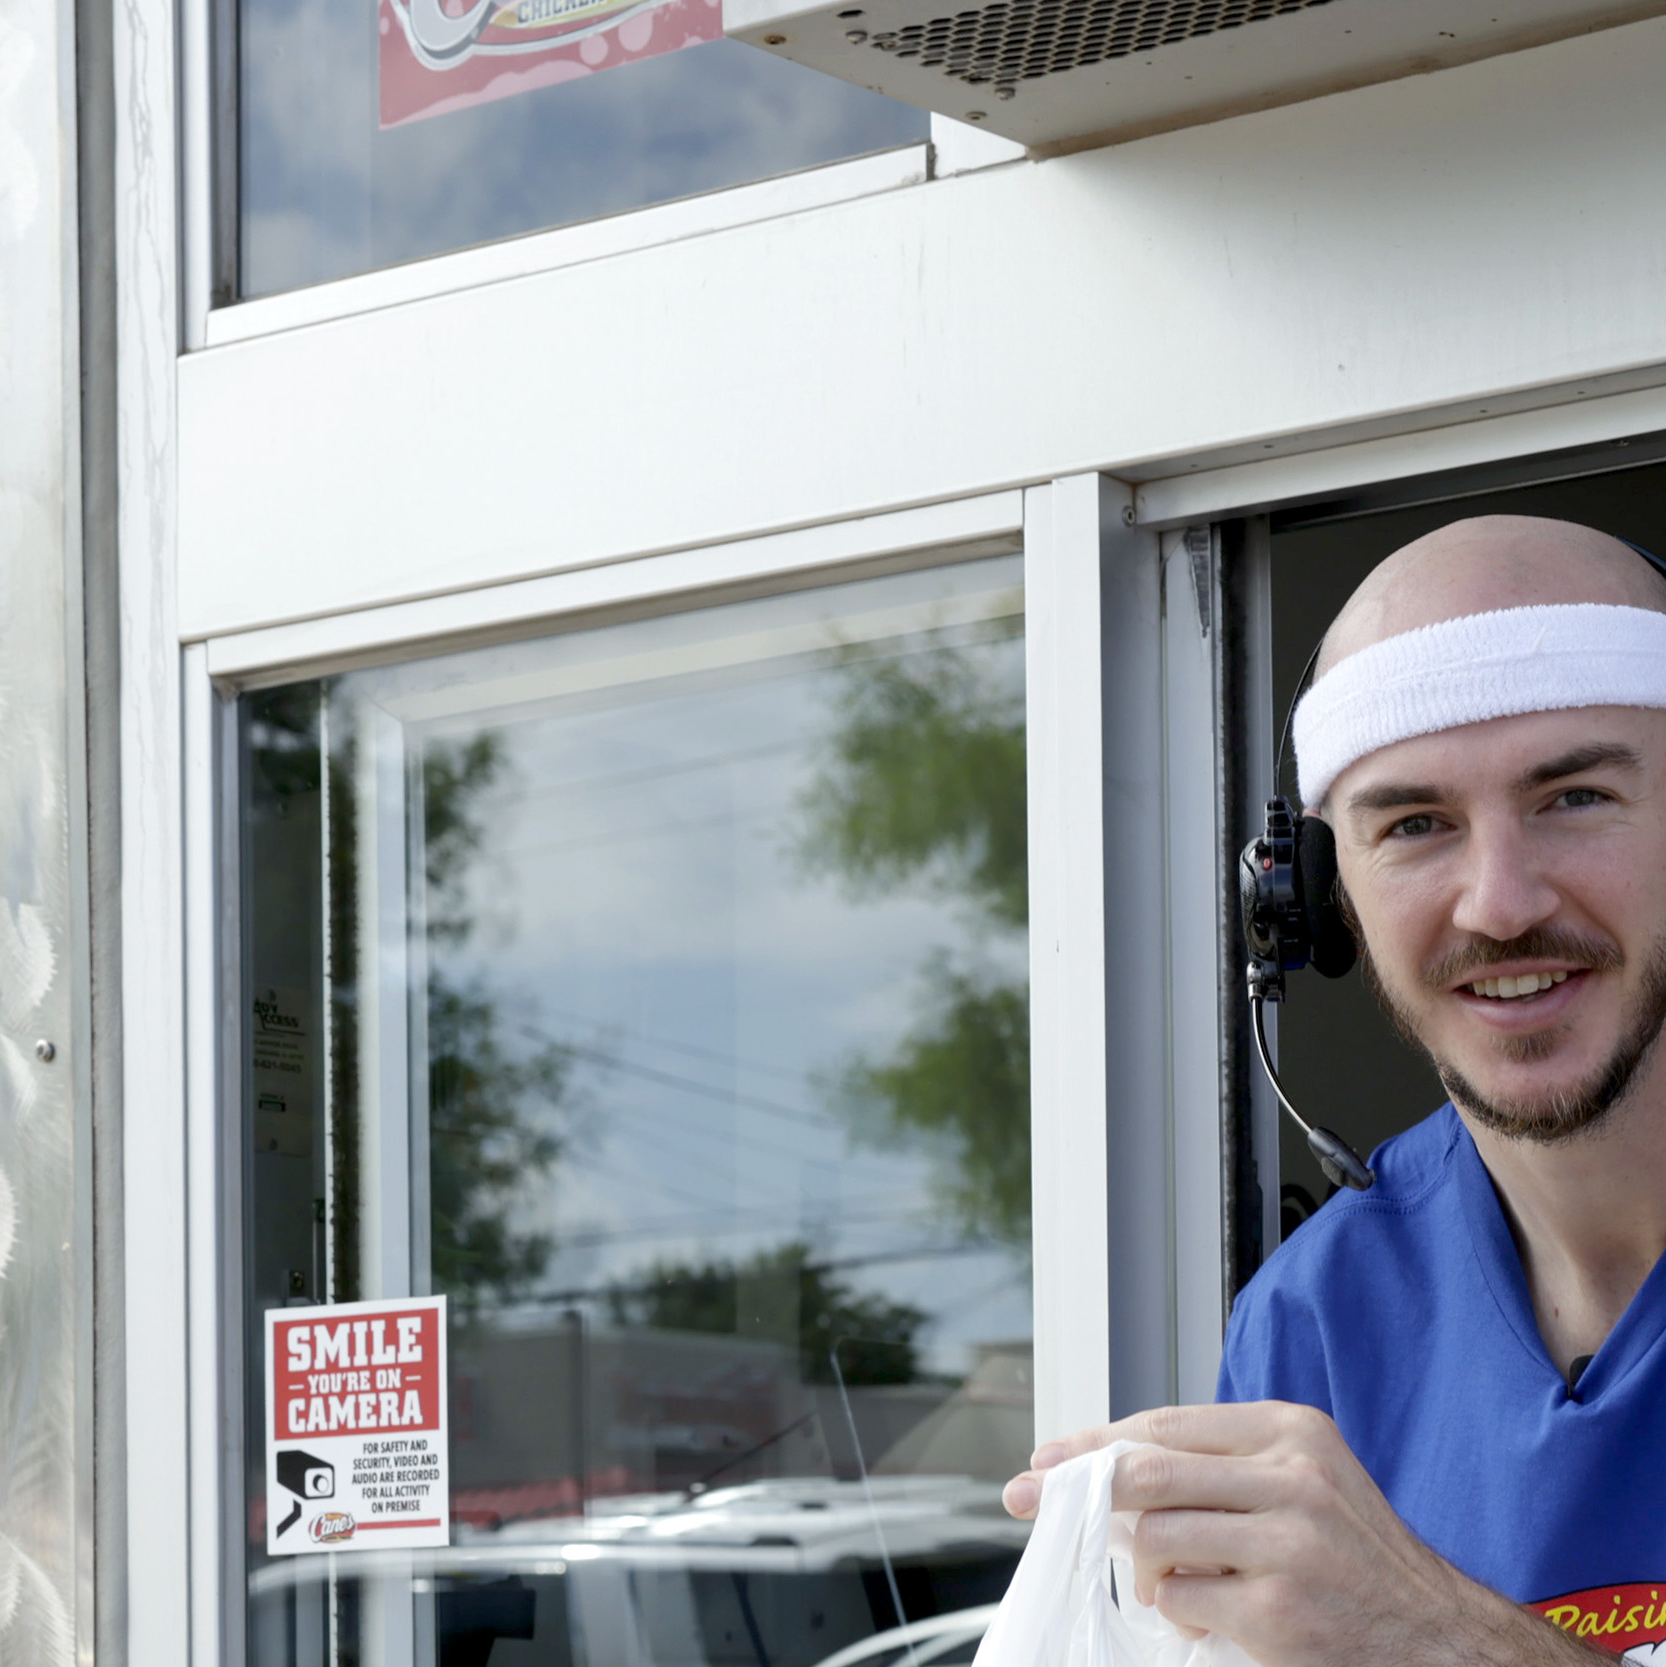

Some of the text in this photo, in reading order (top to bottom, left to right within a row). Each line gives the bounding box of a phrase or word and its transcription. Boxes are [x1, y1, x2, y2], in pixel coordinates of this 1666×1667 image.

[287, 1316, 422, 1372] SMILE
[307, 1368, 401, 1394] YOU'RE ON
[288, 1389, 423, 1433] CAMERA
[363, 1439, 428, 1454] FOR SAFETY AND
[353, 1454, 438, 1470] SECURITY, VIDEO AND
[352, 1469, 440, 1485] AUDIO ARE RECORDED
[362, 1484, 430, 1499] FOR ALL ACTIVITY
[371, 1500, 421, 1513] ON PREMISE
